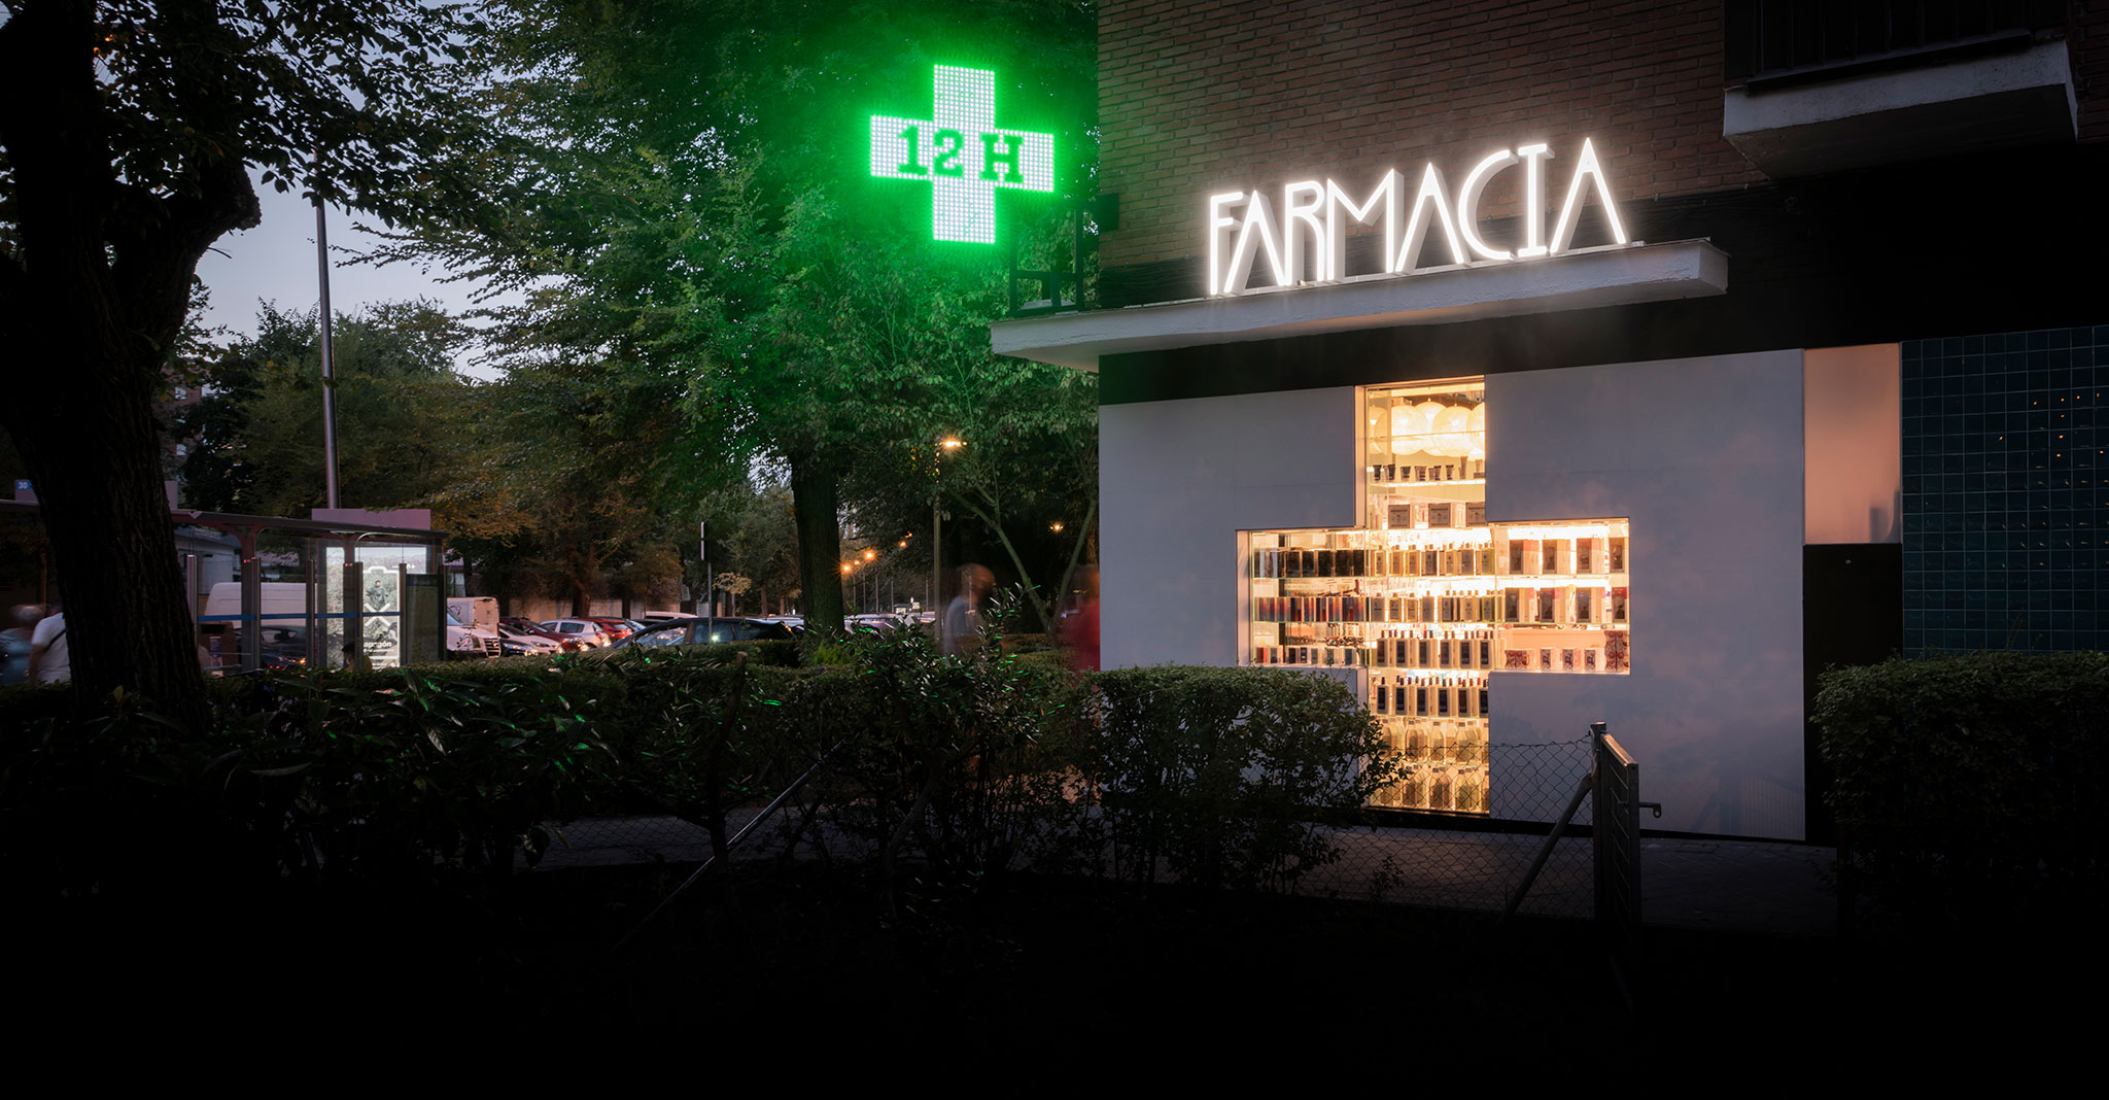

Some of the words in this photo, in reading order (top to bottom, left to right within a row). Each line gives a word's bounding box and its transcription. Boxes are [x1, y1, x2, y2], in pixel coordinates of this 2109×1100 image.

[897, 125, 964, 177] 12
[979, 133, 1024, 184] H
[1208, 136, 1628, 296] FARMACIA
